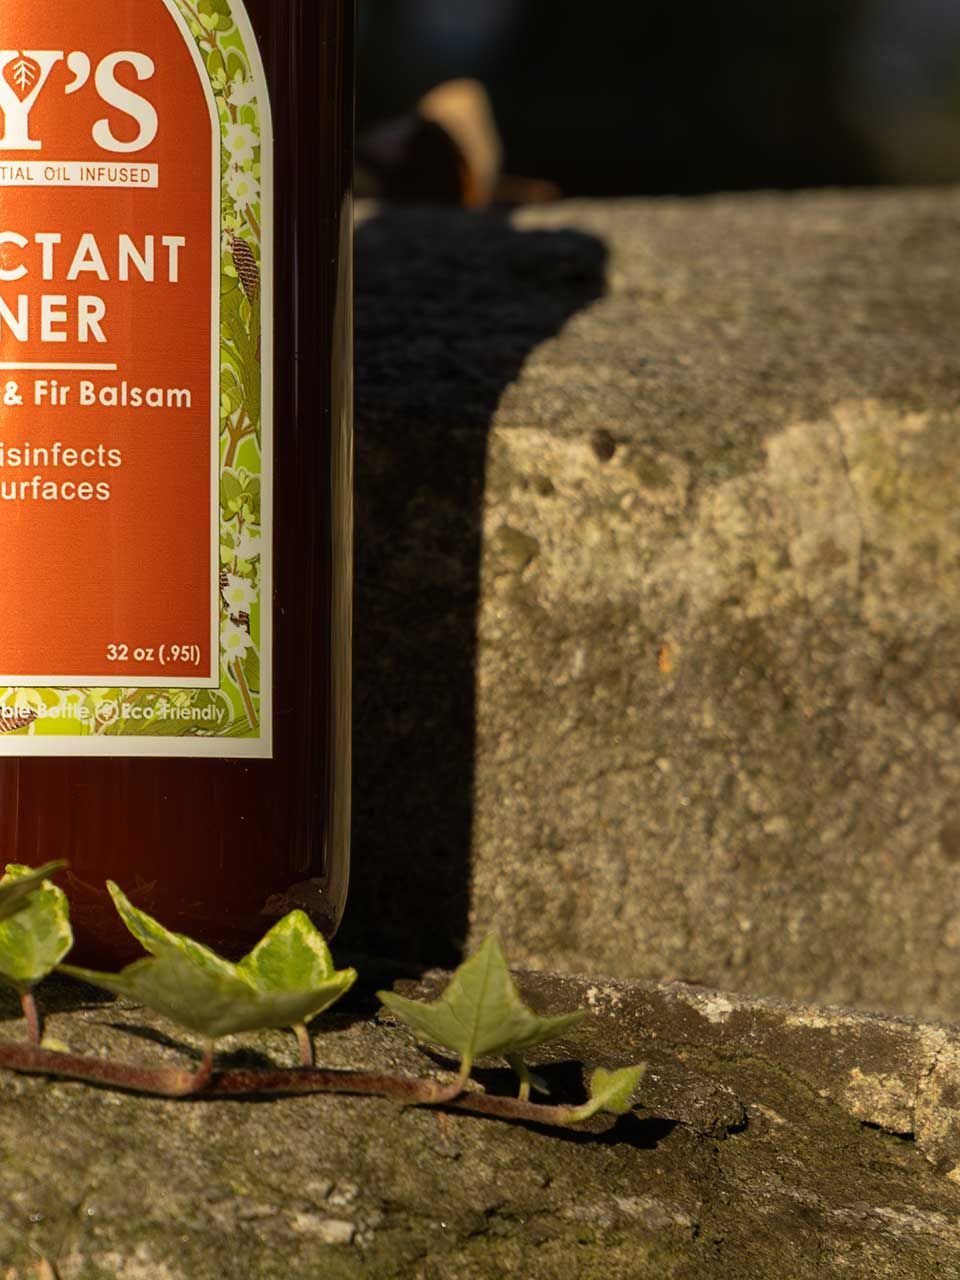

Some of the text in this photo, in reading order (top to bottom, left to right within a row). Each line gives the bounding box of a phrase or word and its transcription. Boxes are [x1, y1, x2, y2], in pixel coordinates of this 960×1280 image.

[44, 167, 71, 181] OIL
[80, 168, 150, 183] INFUSED
[3, 381, 23, 406] &
[34, 379, 71, 406] Fir
[79, 380, 192, 407] Balsam
[106, 644, 129, 661] 32
[133, 648, 154, 661] oz
